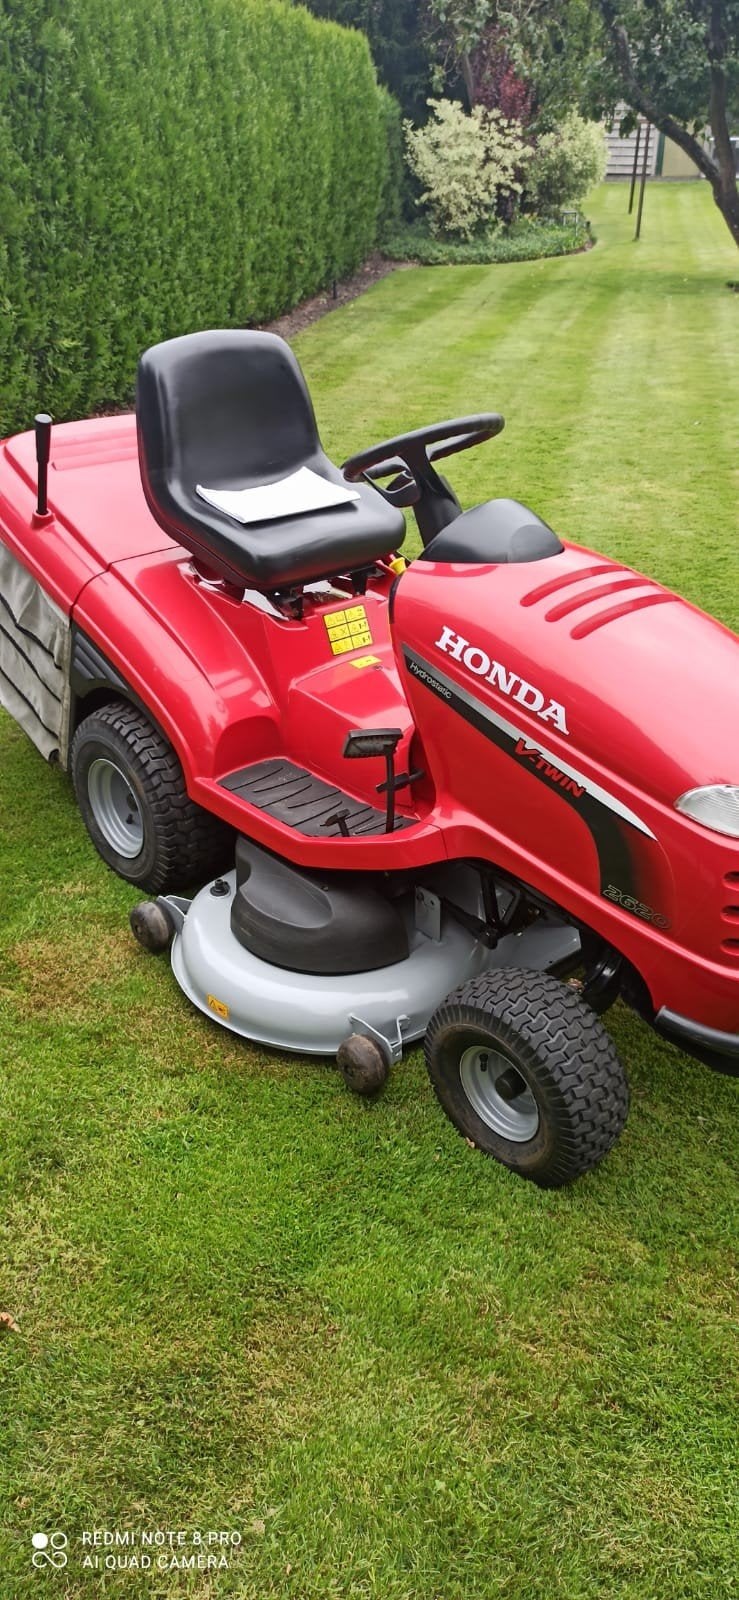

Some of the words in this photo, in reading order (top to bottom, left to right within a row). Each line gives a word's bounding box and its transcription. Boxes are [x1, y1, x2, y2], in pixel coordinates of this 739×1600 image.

[409, 662, 453, 699] Hydrostatic
[435, 626, 569, 735] HONDA
[514, 737, 587, 798] V-TWIN
[602, 884, 672, 930] 2620
